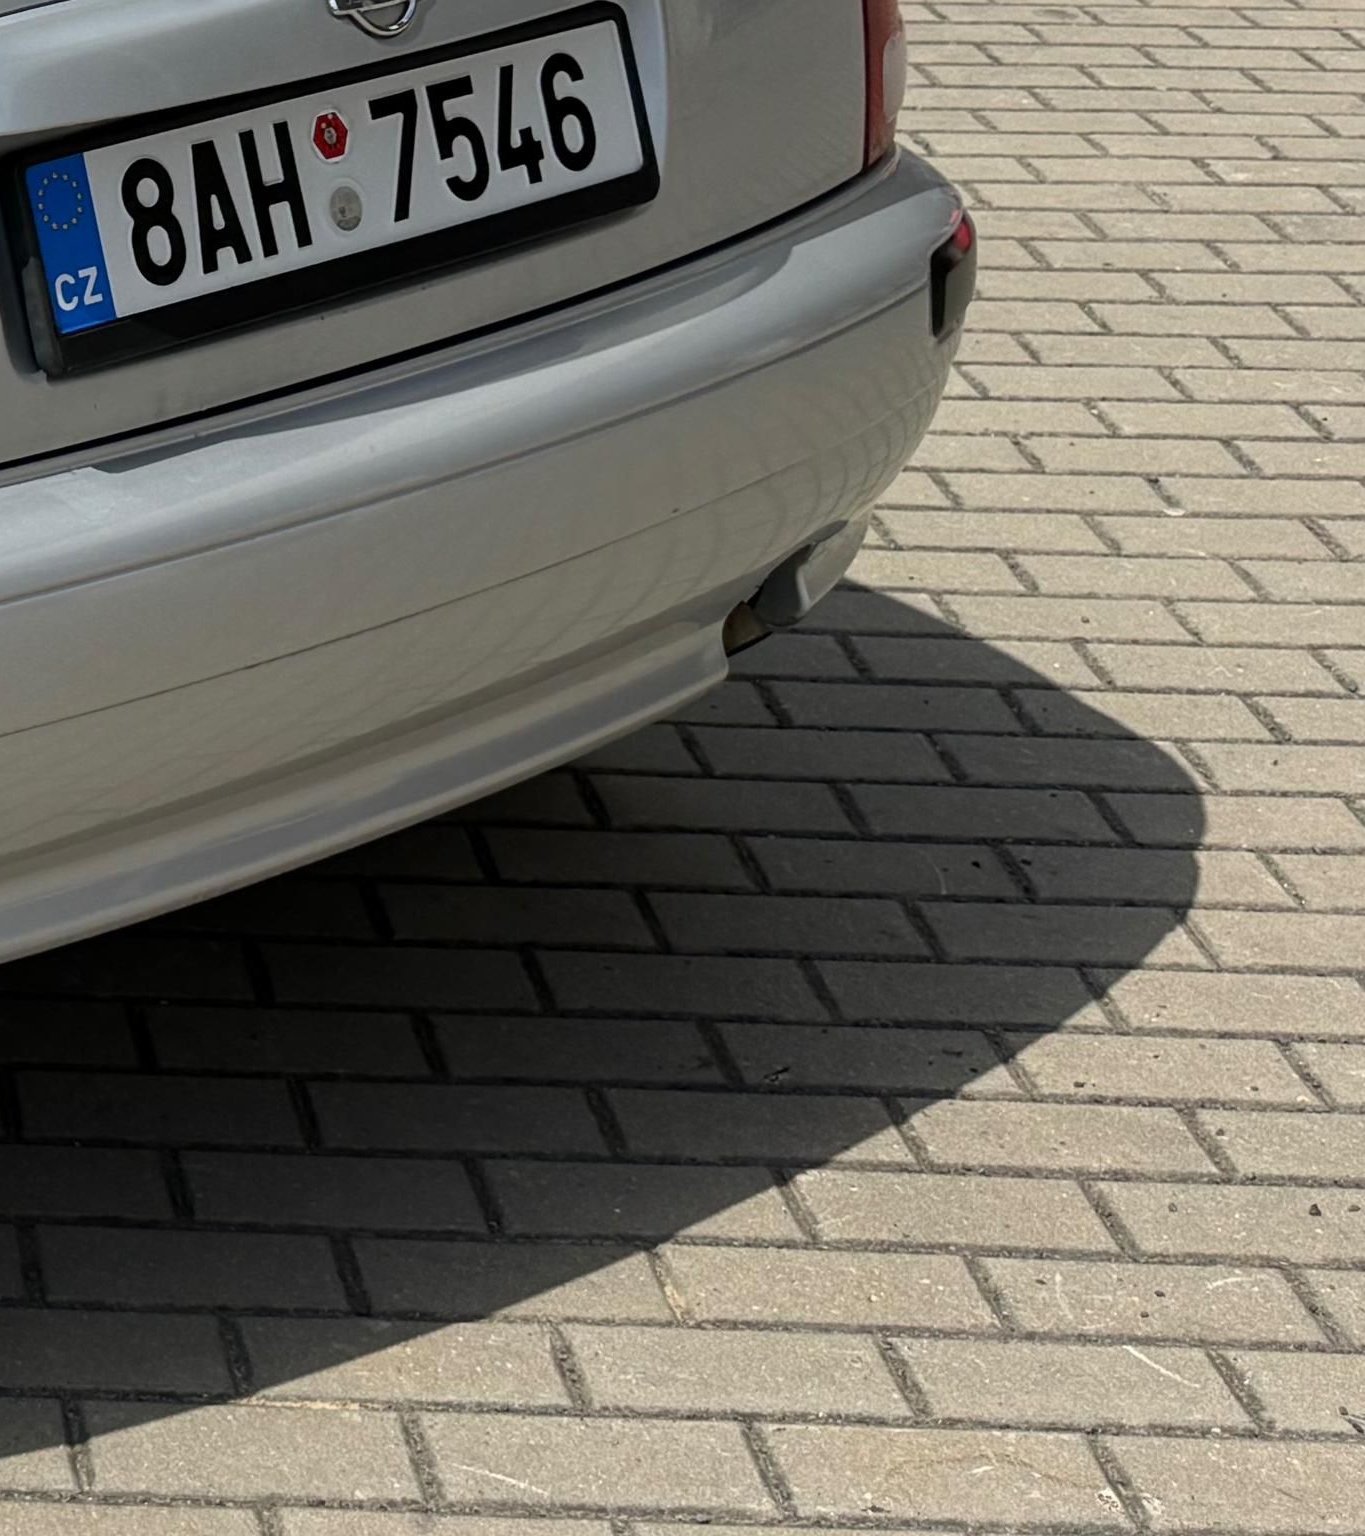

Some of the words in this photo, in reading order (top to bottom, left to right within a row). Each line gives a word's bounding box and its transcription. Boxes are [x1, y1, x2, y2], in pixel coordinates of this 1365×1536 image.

[121, 120, 312, 286] 8AH
[369, 53, 596, 223] 7546
[55, 265, 104, 312] CZ
